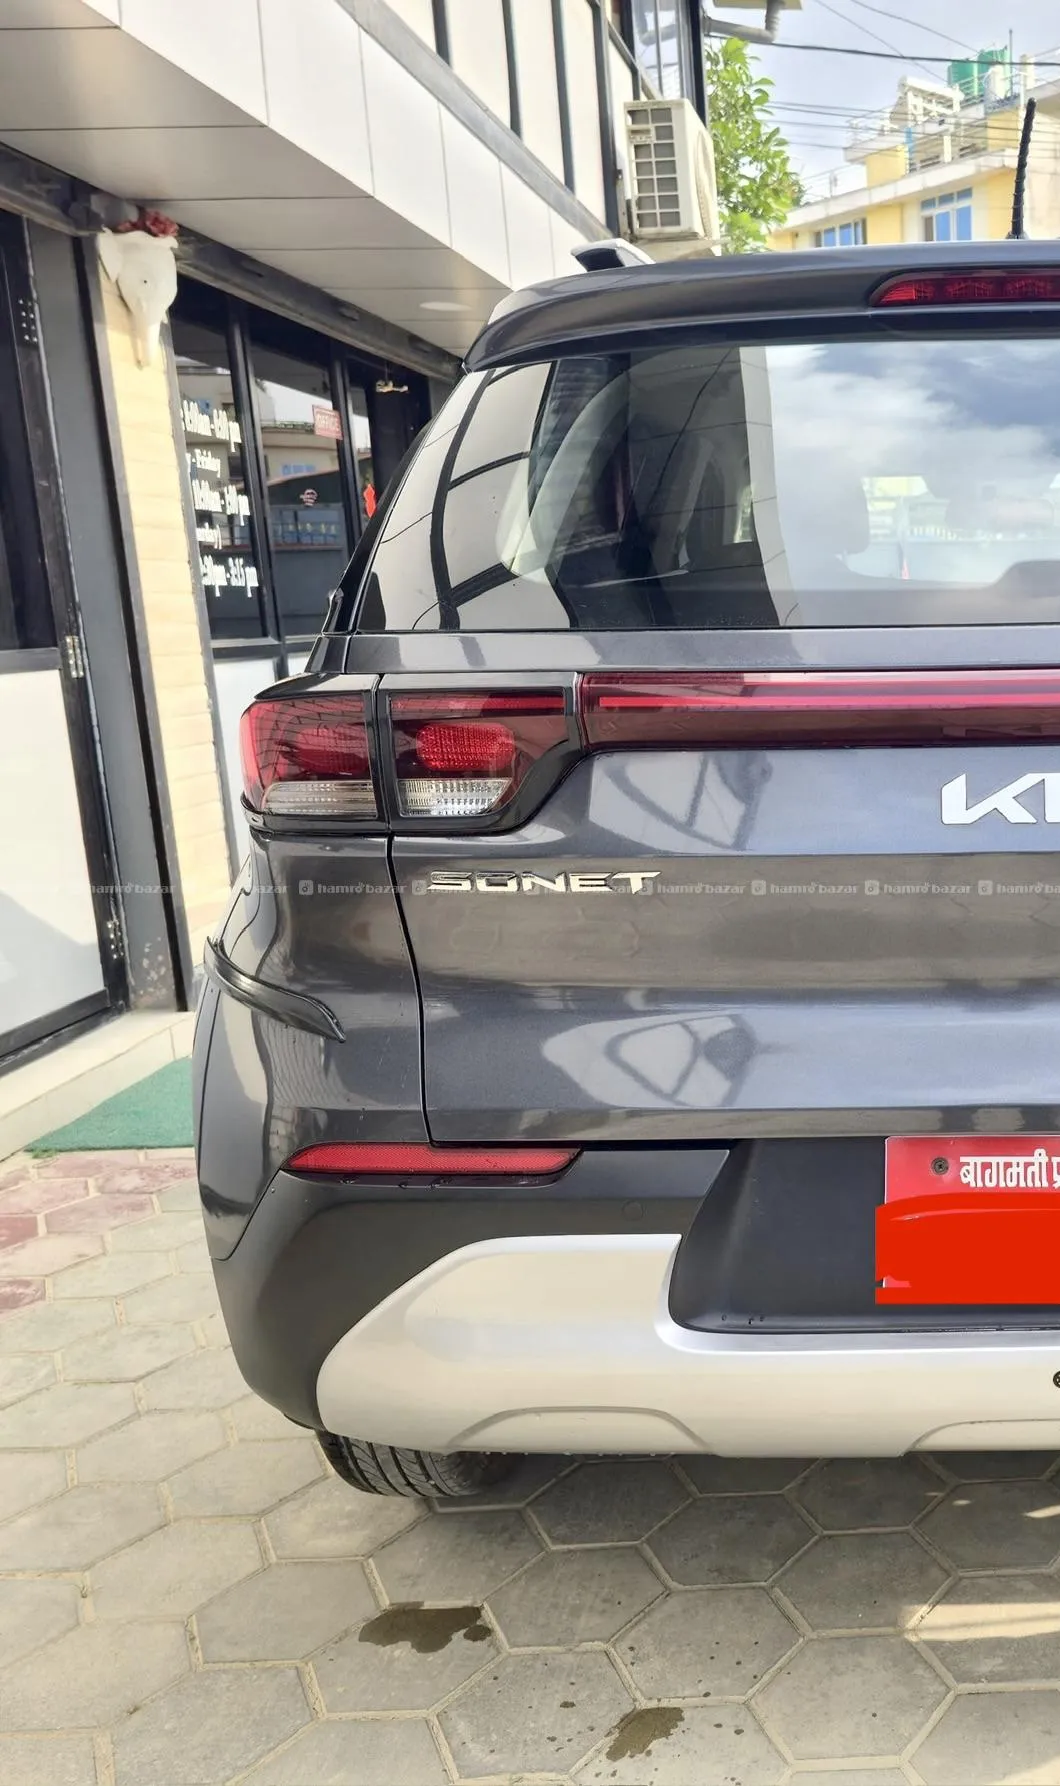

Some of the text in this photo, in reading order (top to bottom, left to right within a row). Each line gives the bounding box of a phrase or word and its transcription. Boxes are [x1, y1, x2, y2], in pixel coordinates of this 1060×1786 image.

[194, 448, 221, 478] Friday
[427, 871, 661, 894] SONET
[960, 1148, 1048, 1188] बागमती
